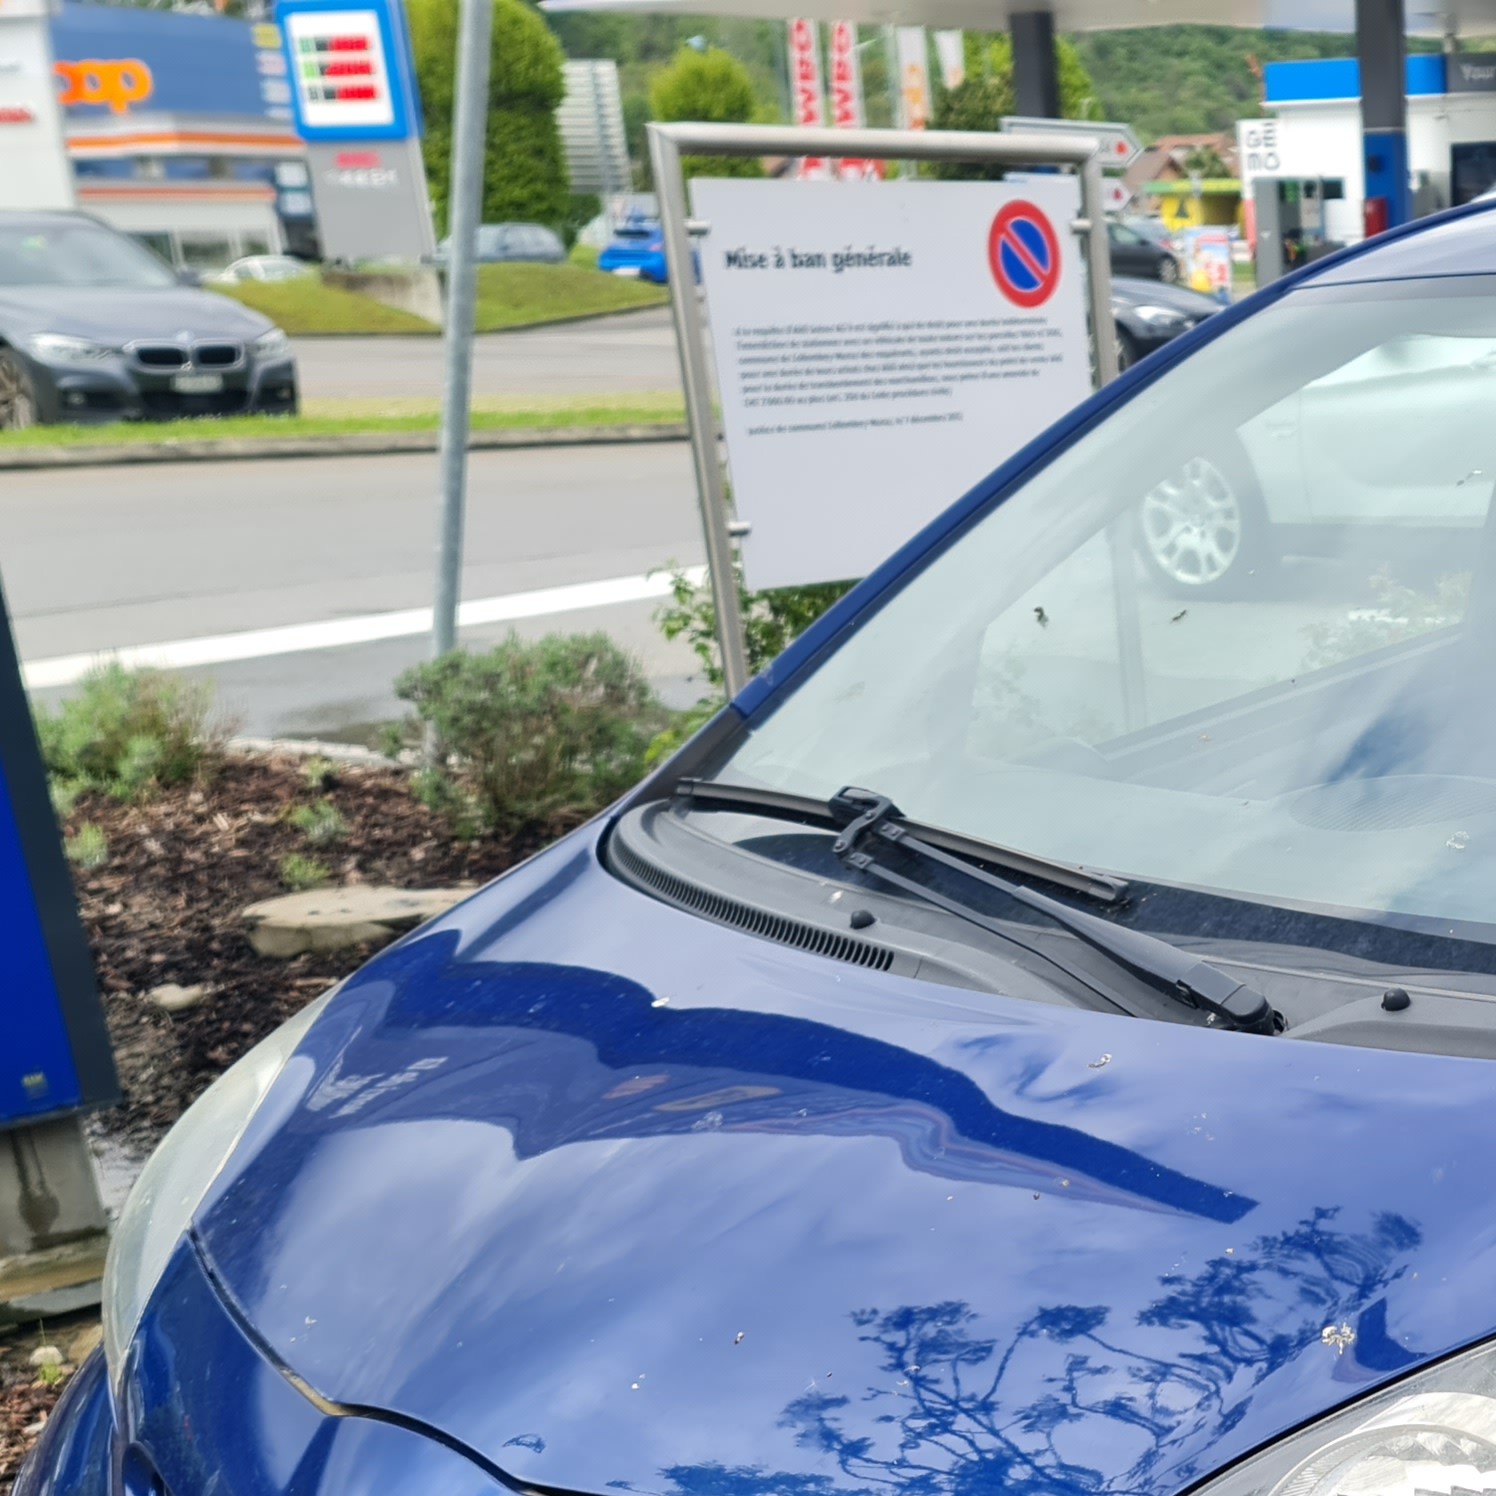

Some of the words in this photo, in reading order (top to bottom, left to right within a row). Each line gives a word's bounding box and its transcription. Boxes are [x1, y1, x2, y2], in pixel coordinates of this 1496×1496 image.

[1459, 63, 1496, 81] Your
[724, 247, 768, 269] Mise
[773, 246, 786, 269] à
[790, 246, 827, 269] ban
[832, 244, 913, 274] générale
